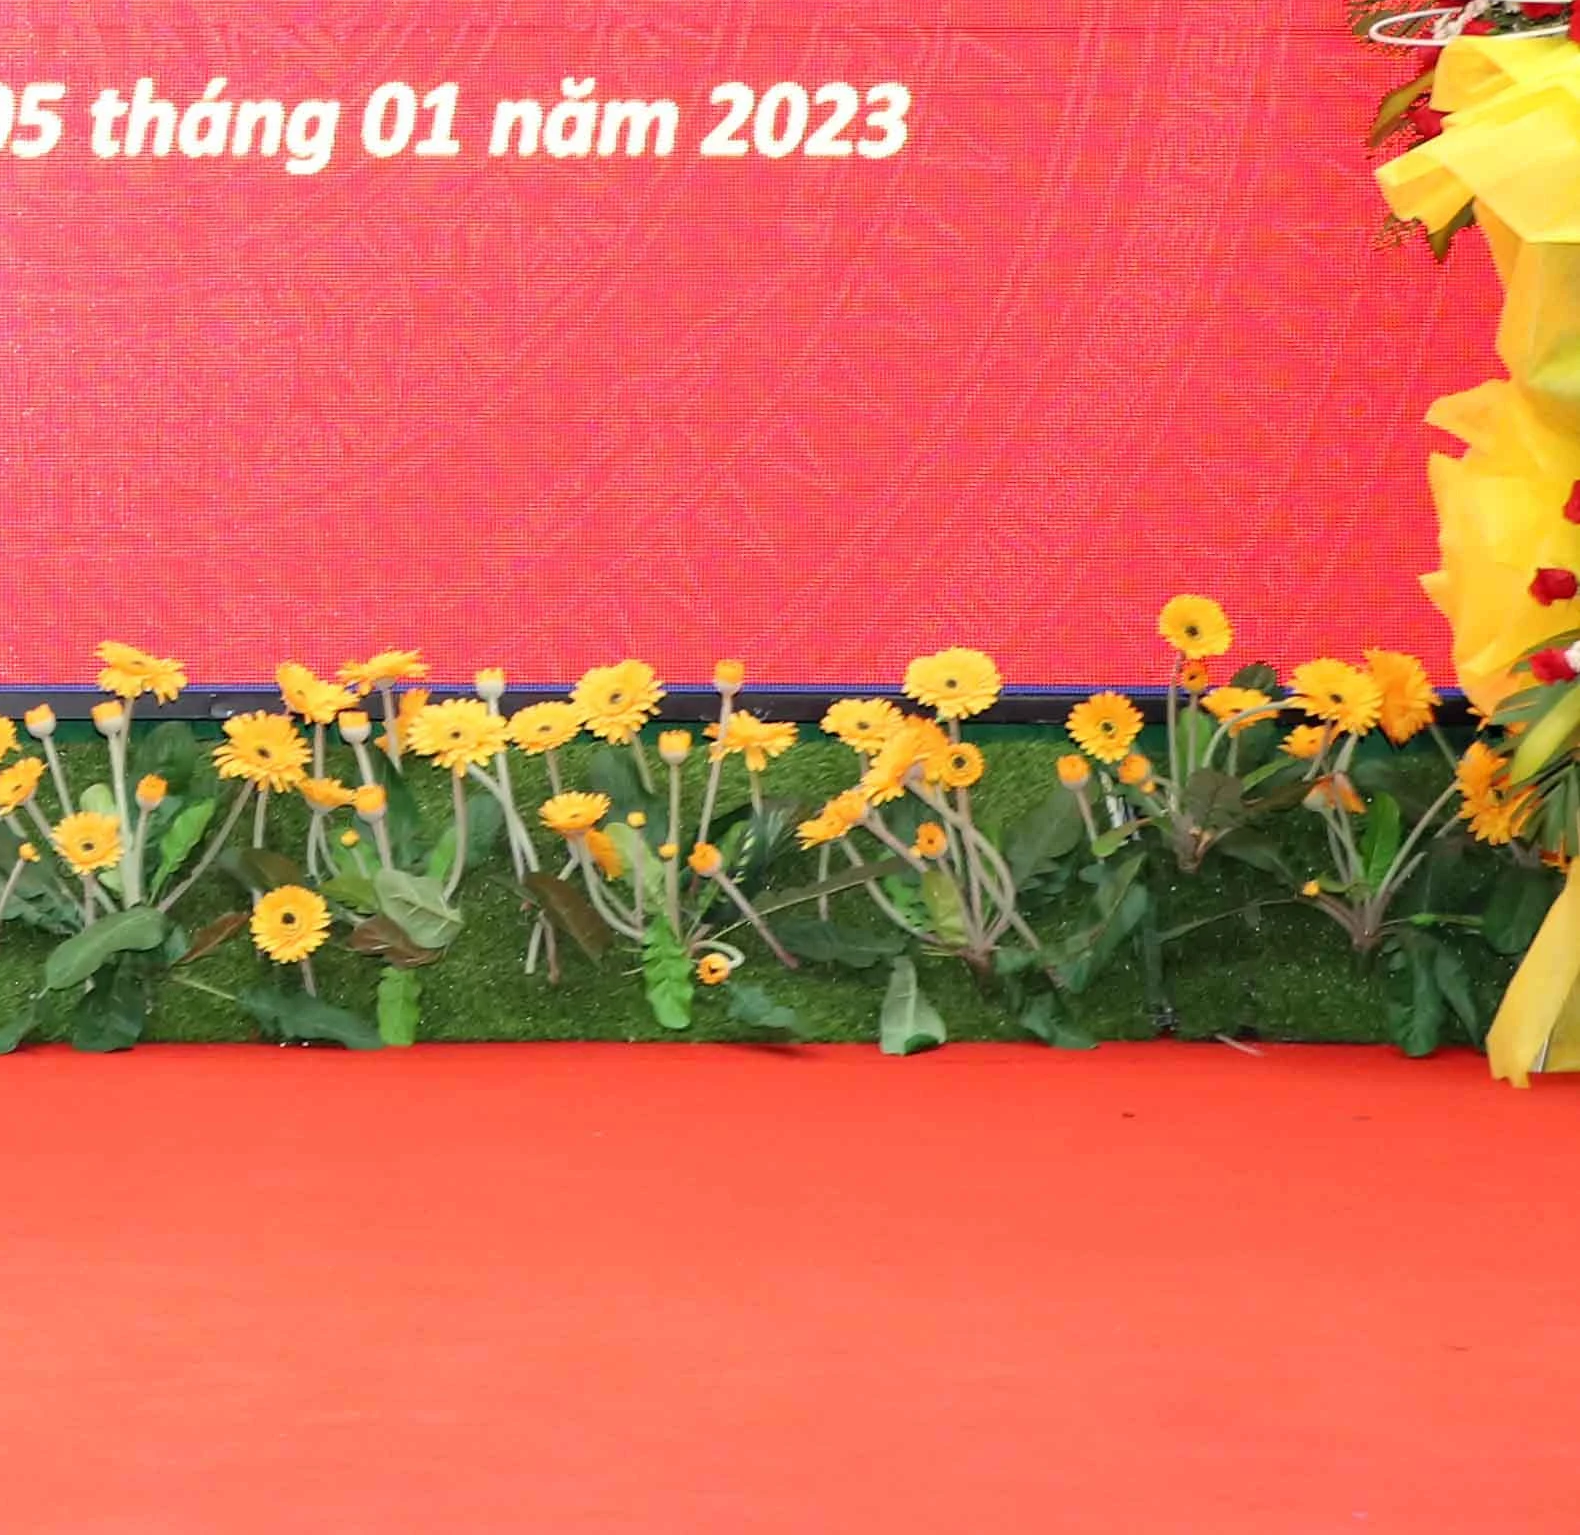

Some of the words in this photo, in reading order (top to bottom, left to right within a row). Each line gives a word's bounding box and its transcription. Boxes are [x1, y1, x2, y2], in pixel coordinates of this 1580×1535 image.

[87, 76, 342, 176] tháng
[361, 81, 461, 159] 01
[487, 76, 680, 159] năm
[699, 81, 912, 160] 2023
